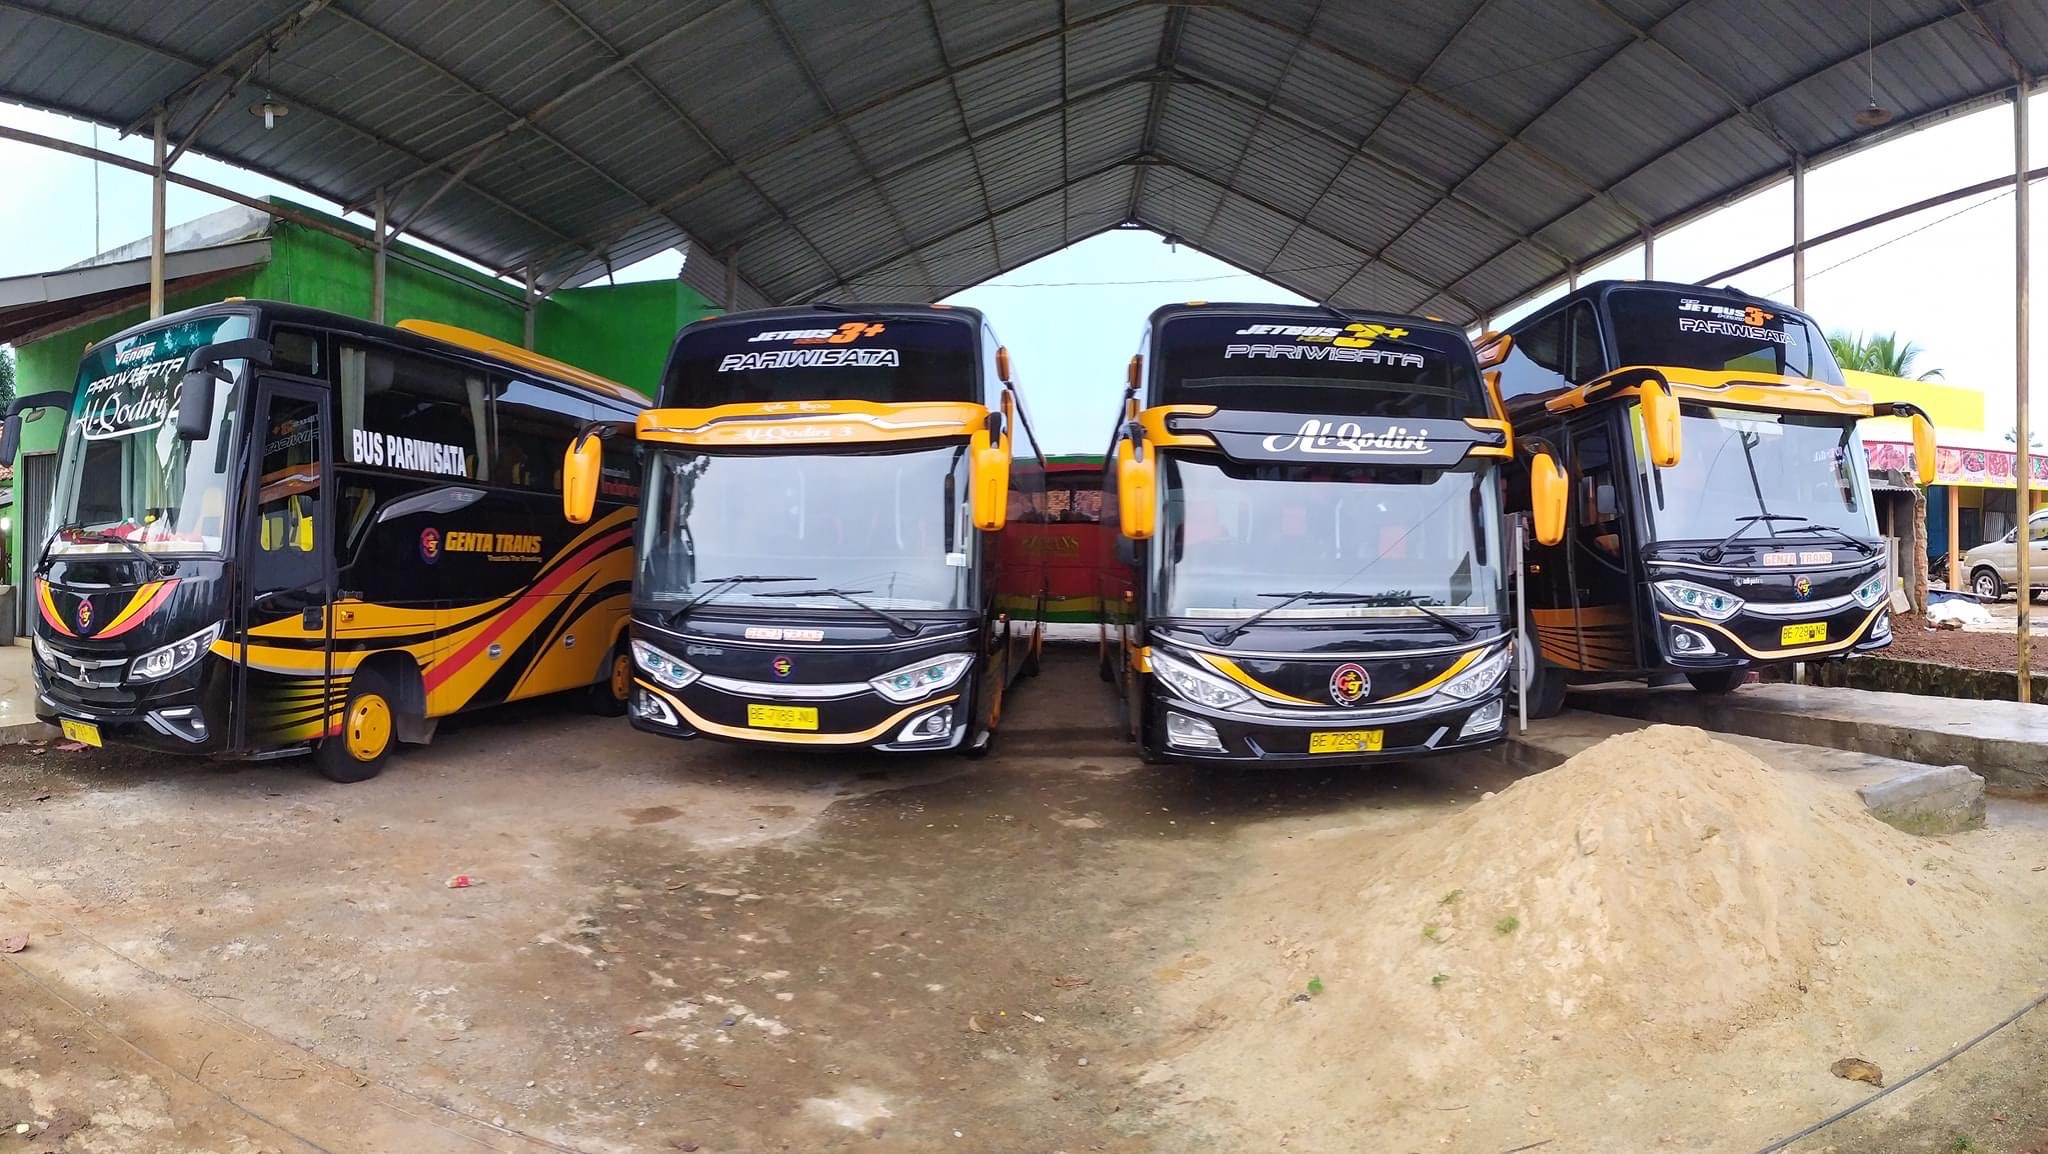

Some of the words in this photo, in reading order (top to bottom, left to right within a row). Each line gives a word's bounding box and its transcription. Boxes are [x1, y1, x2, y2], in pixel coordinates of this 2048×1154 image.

[748, 328, 837, 342] JETBUS
[1235, 324, 1343, 337] JETBUS
[1679, 317, 1797, 346] PARIWISATA
[718, 348, 900, 372] PARIWISATA
[85, 357, 186, 397] PARIWISATA
[1262, 418, 1433, 455] Al-Qodiri
[352, 429, 384, 466] BUS
[386, 434, 468, 478] PARIWISATA
[444, 531, 494, 552] GENTA
[496, 533, 542, 554] TRANS
[751, 707, 765, 720] BE
[1312, 734, 1328, 747] BE
